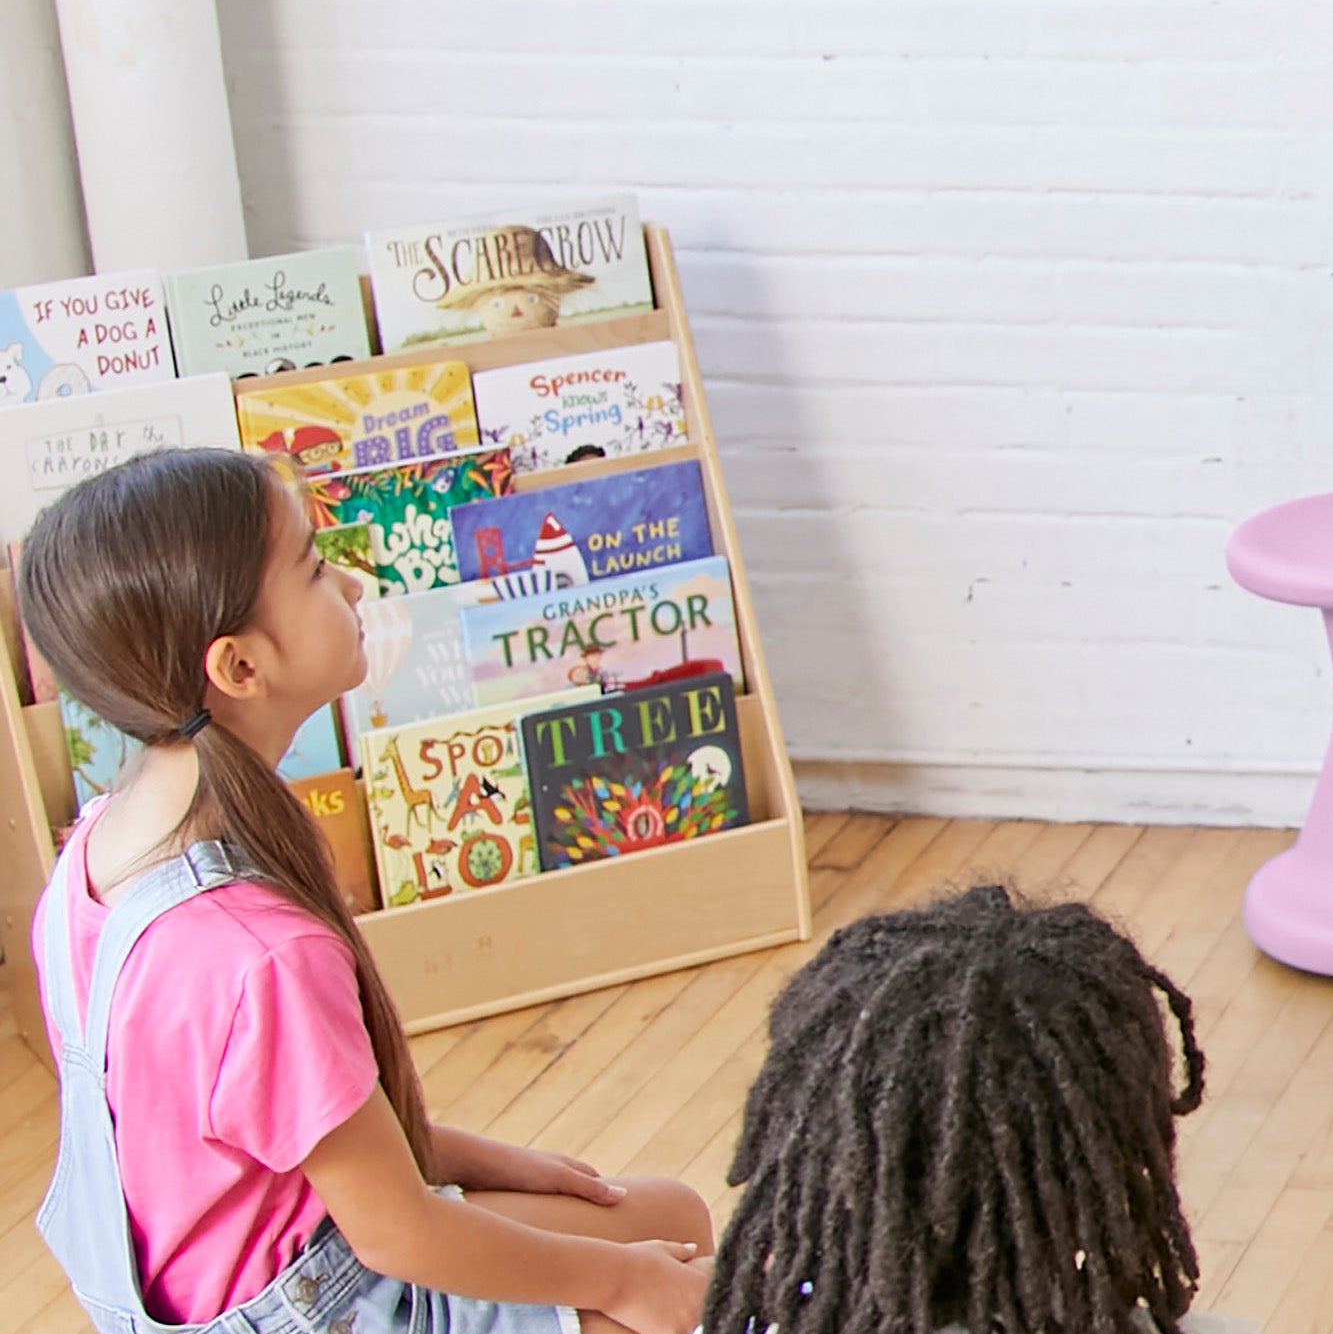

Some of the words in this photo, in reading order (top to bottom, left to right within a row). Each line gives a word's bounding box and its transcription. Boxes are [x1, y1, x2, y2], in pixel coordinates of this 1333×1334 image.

[387, 239, 423, 268] THE
[412, 215, 626, 303] SCARECROW
[33, 299, 54, 323] IF
[60, 295, 99, 317] YOU
[104, 288, 155, 310] GIVE
[204, 283, 263, 327] Little
[264, 270, 335, 312] Legends
[77, 328, 89, 350] A
[95, 321, 138, 344] DOG
[145, 317, 157, 338] A
[97, 345, 159, 376] DONUT
[529, 369, 626, 397] Spencer
[363, 402, 430, 434] Dream
[543, 404, 622, 436] Spring
[89, 430, 125, 452] DAY
[353, 415, 458, 467] BIG
[588, 531, 623, 552] ON
[632, 517, 680, 544] THE
[591, 542, 682, 576] LAUNCH
[542, 582, 659, 621] GRANDPA'S
[492, 594, 713, 668] TRACTOR
[536, 685, 727, 766] TREE
[419, 735, 504, 781] SPO
[302, 788, 345, 817] ks
[446, 773, 504, 832] A
[412, 832, 513, 901] LO
